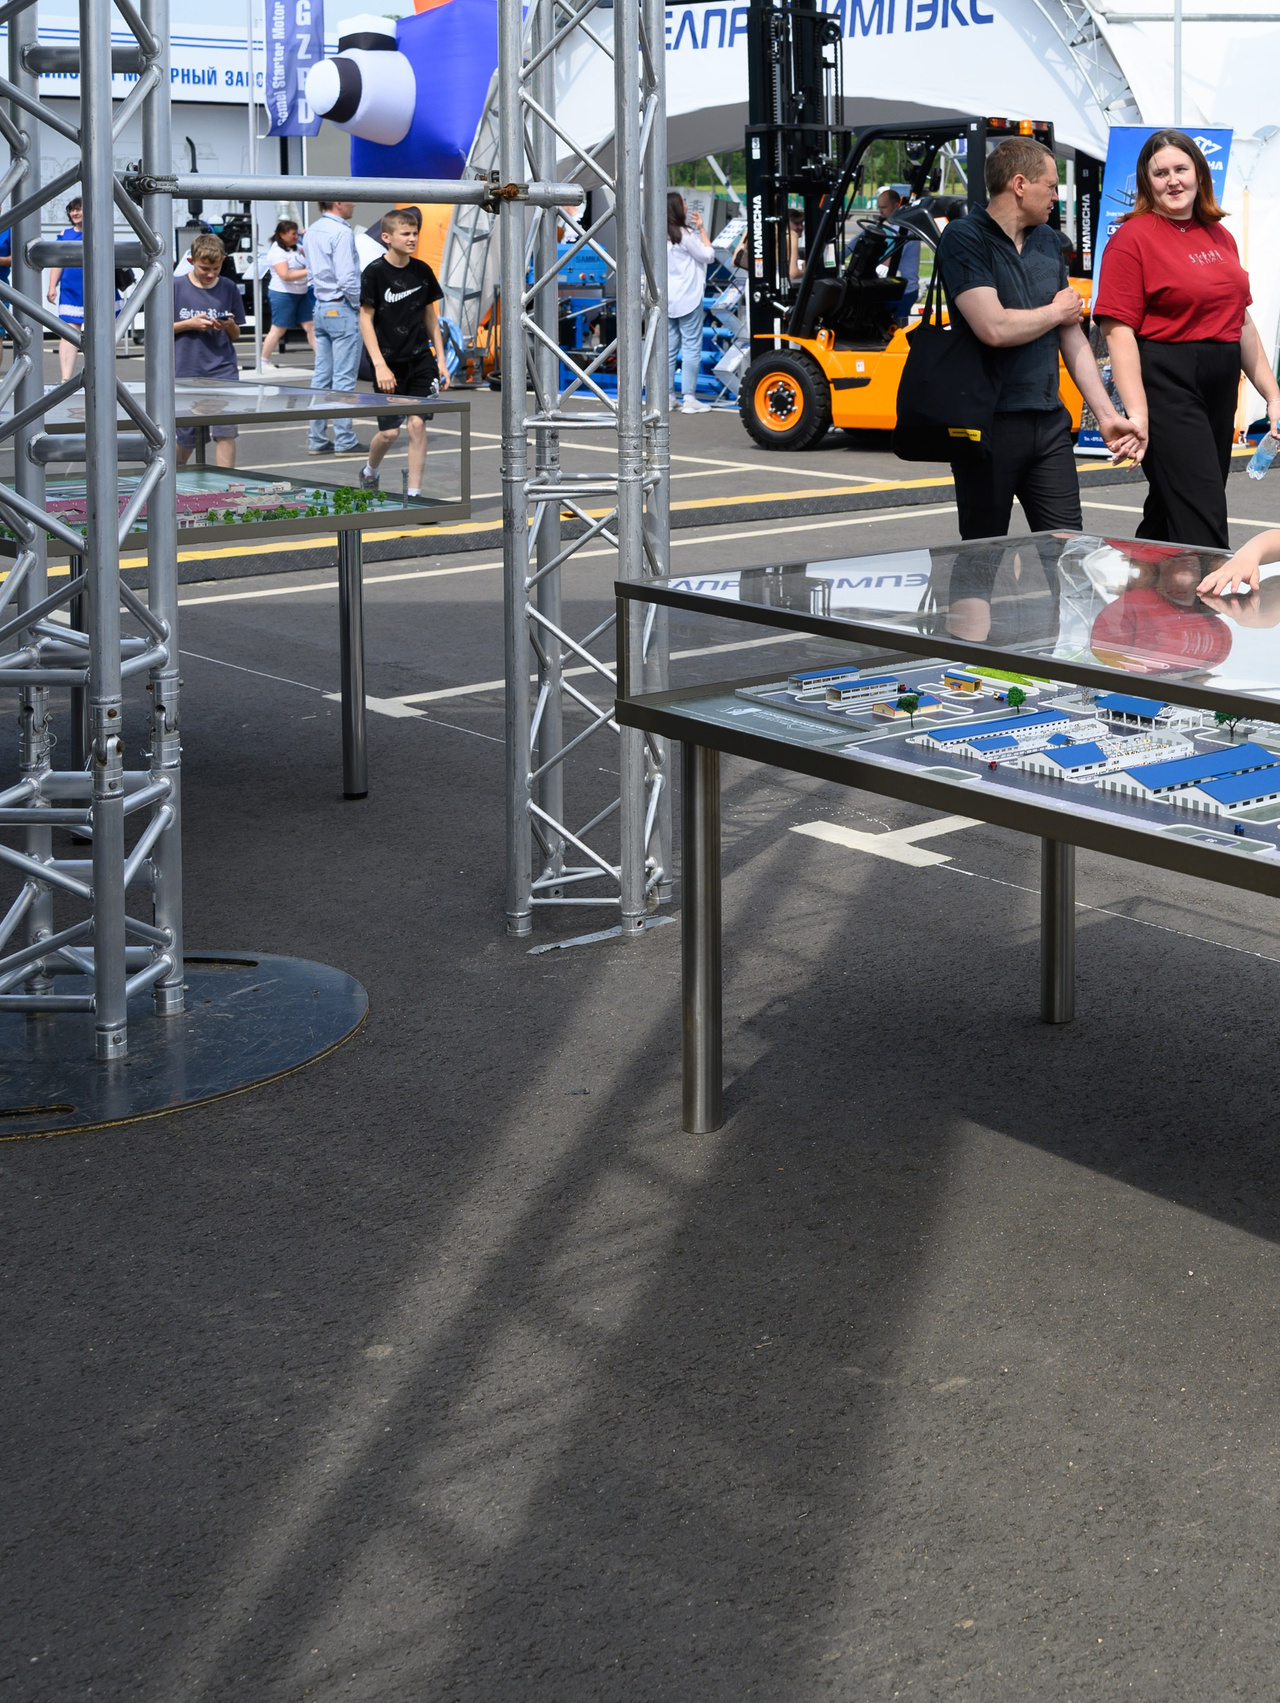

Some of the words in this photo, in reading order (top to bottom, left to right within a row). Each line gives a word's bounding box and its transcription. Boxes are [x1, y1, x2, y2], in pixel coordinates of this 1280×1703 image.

[272, 1, 286, 39] Motor
[272, 43, 286, 89] Starter
[753, 195, 763, 258] HANGCHA
[1082, 194, 1091, 252] HANGCHA
